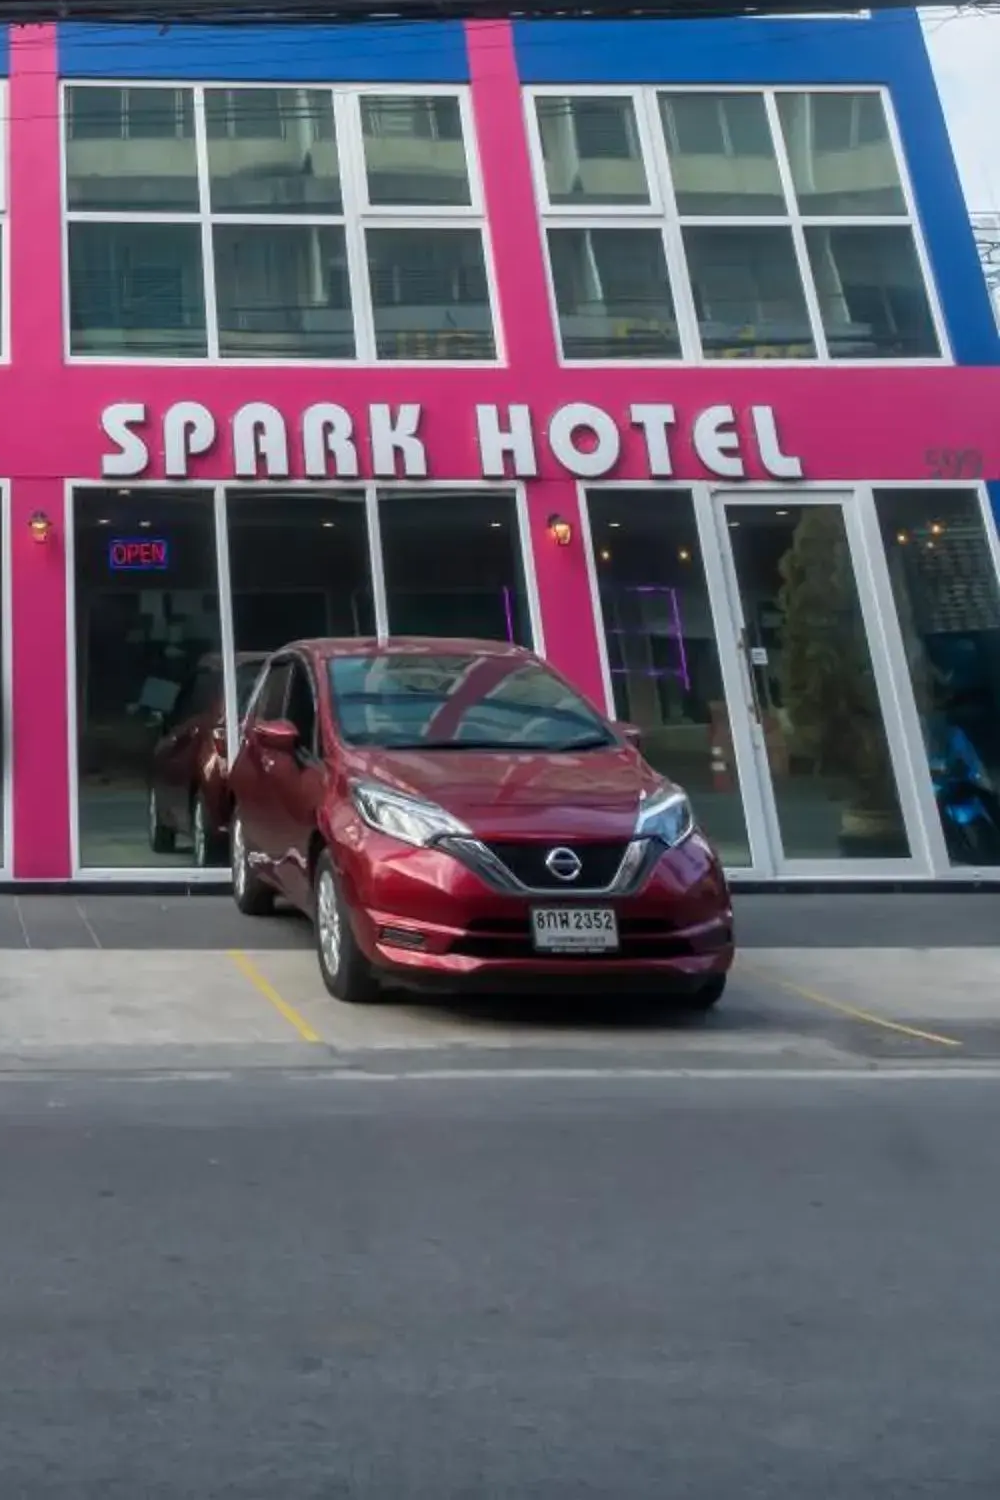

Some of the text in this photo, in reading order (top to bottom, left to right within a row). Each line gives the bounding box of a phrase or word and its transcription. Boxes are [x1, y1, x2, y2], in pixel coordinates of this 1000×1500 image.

[99, 400, 805, 480] SPARK HOTEL
[112, 542, 166, 566] OPEN
[573, 911, 613, 931] 2352
